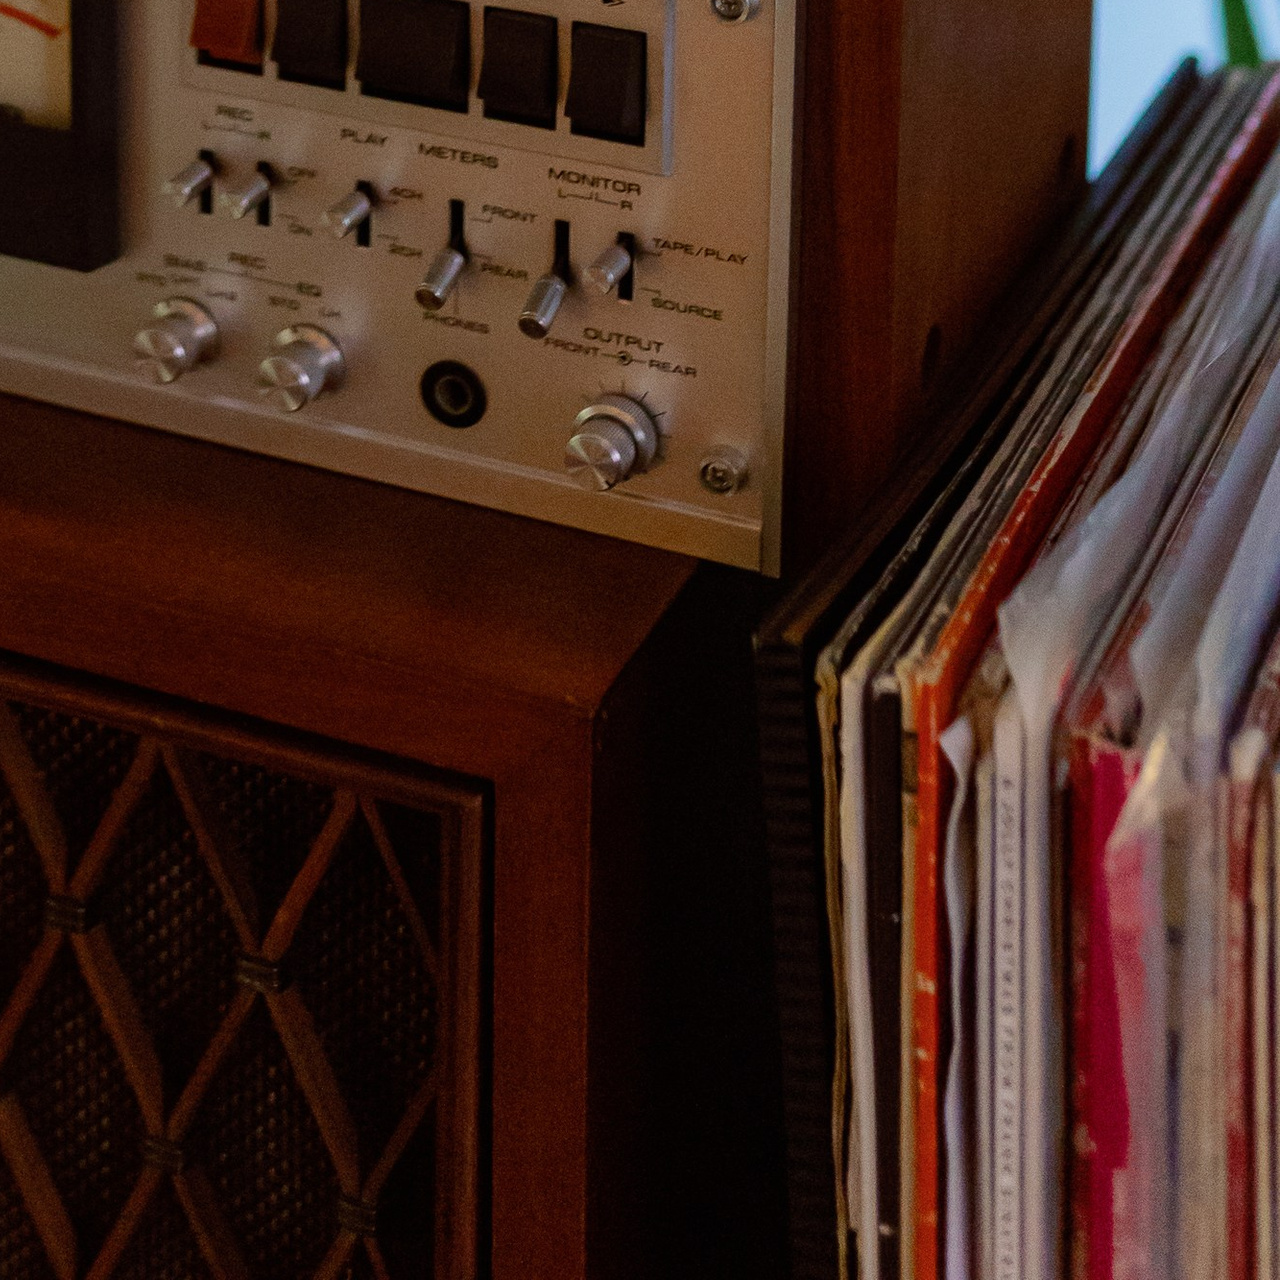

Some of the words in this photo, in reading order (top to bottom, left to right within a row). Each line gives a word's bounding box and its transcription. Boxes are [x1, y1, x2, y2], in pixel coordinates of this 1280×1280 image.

[340, 128, 388, 146] PLAY
[419, 143, 499, 169] METERS
[548, 167, 642, 197] MONITOR
[482, 203, 538, 224] FRONT
[653, 237, 749, 266] TAPE/PLAY
[482, 262, 528, 281] REAR
[651, 296, 724, 321] SOURCE
[423, 311, 489, 335] PHONES
[584, 327, 664, 354] OUTPUT
[543, 339, 600, 359] FRONT
[649, 360, 698, 378] REAR
